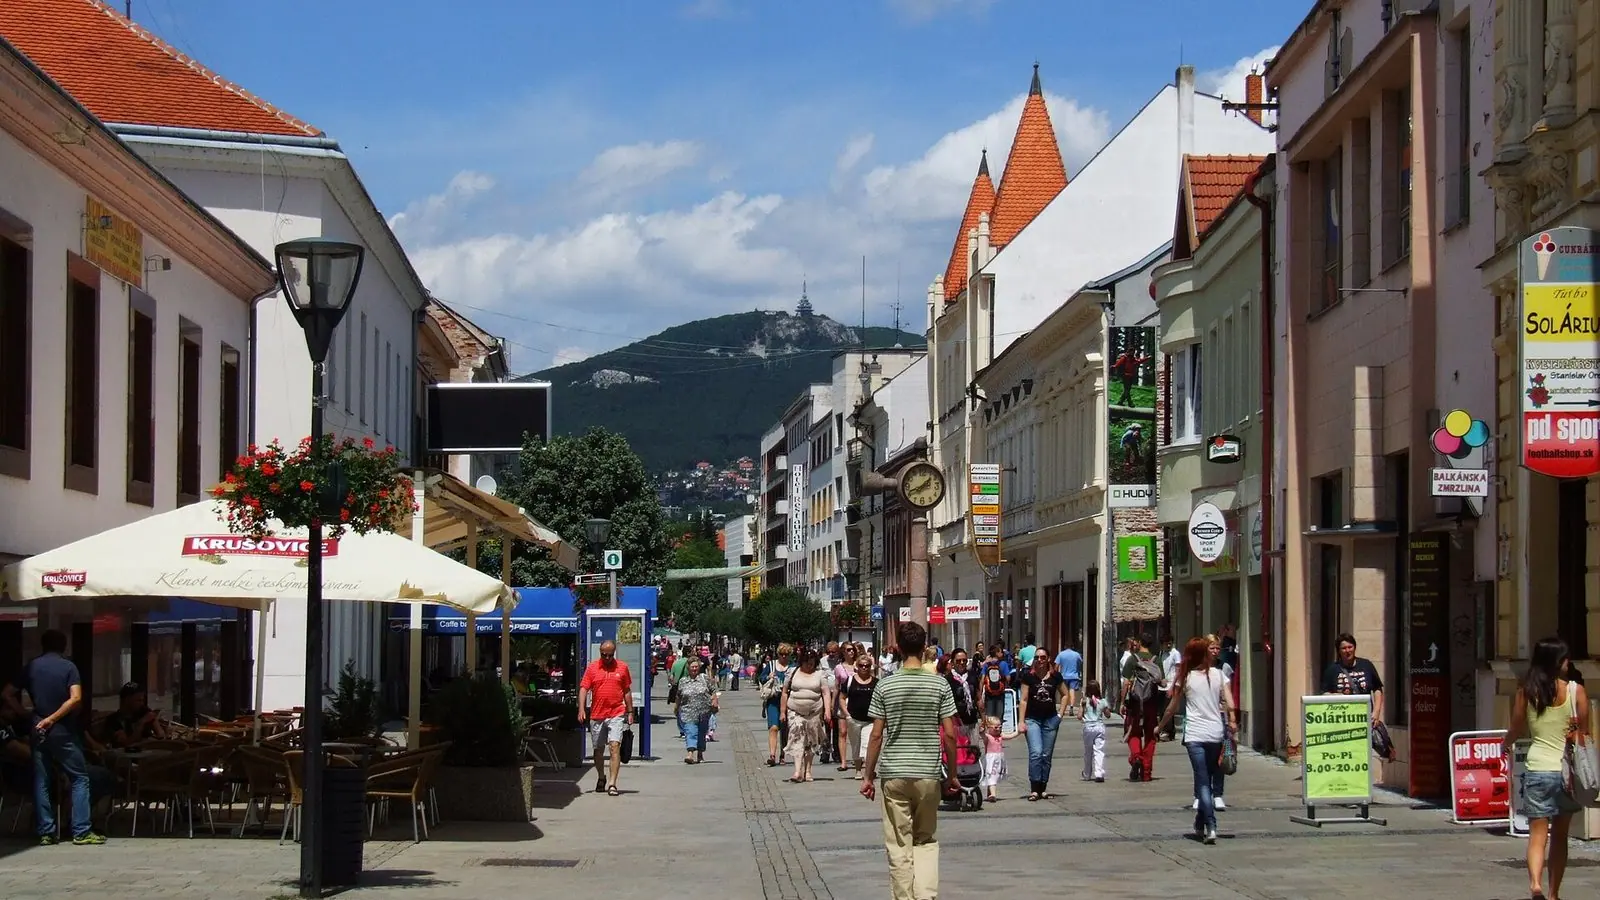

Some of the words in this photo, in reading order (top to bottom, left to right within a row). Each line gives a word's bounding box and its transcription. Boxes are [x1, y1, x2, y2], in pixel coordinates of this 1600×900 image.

[1550, 371, 1587, 379] Stanislav
[1528, 414, 1551, 444] pd
[1528, 448, 1594, 459] footballshop.sk
[1433, 471, 1487, 482] BALKÁNSKA
[1437, 483, 1481, 493] ZMRZLINA
[1122, 489, 1153, 498] HUDY
[155, 568, 208, 589] Klenot
[211, 570, 254, 590] medzi
[439, 620, 459, 628] Caffe
[513, 623, 541, 631] PEPSI
[549, 620, 567, 628] Caffe
[1306, 711, 1368, 724] Solárium
[1322, 751, 1353, 760] Po-Pi
[1455, 741, 1470, 762] pd
[1306, 763, 1369, 773] 8.00-20.00
